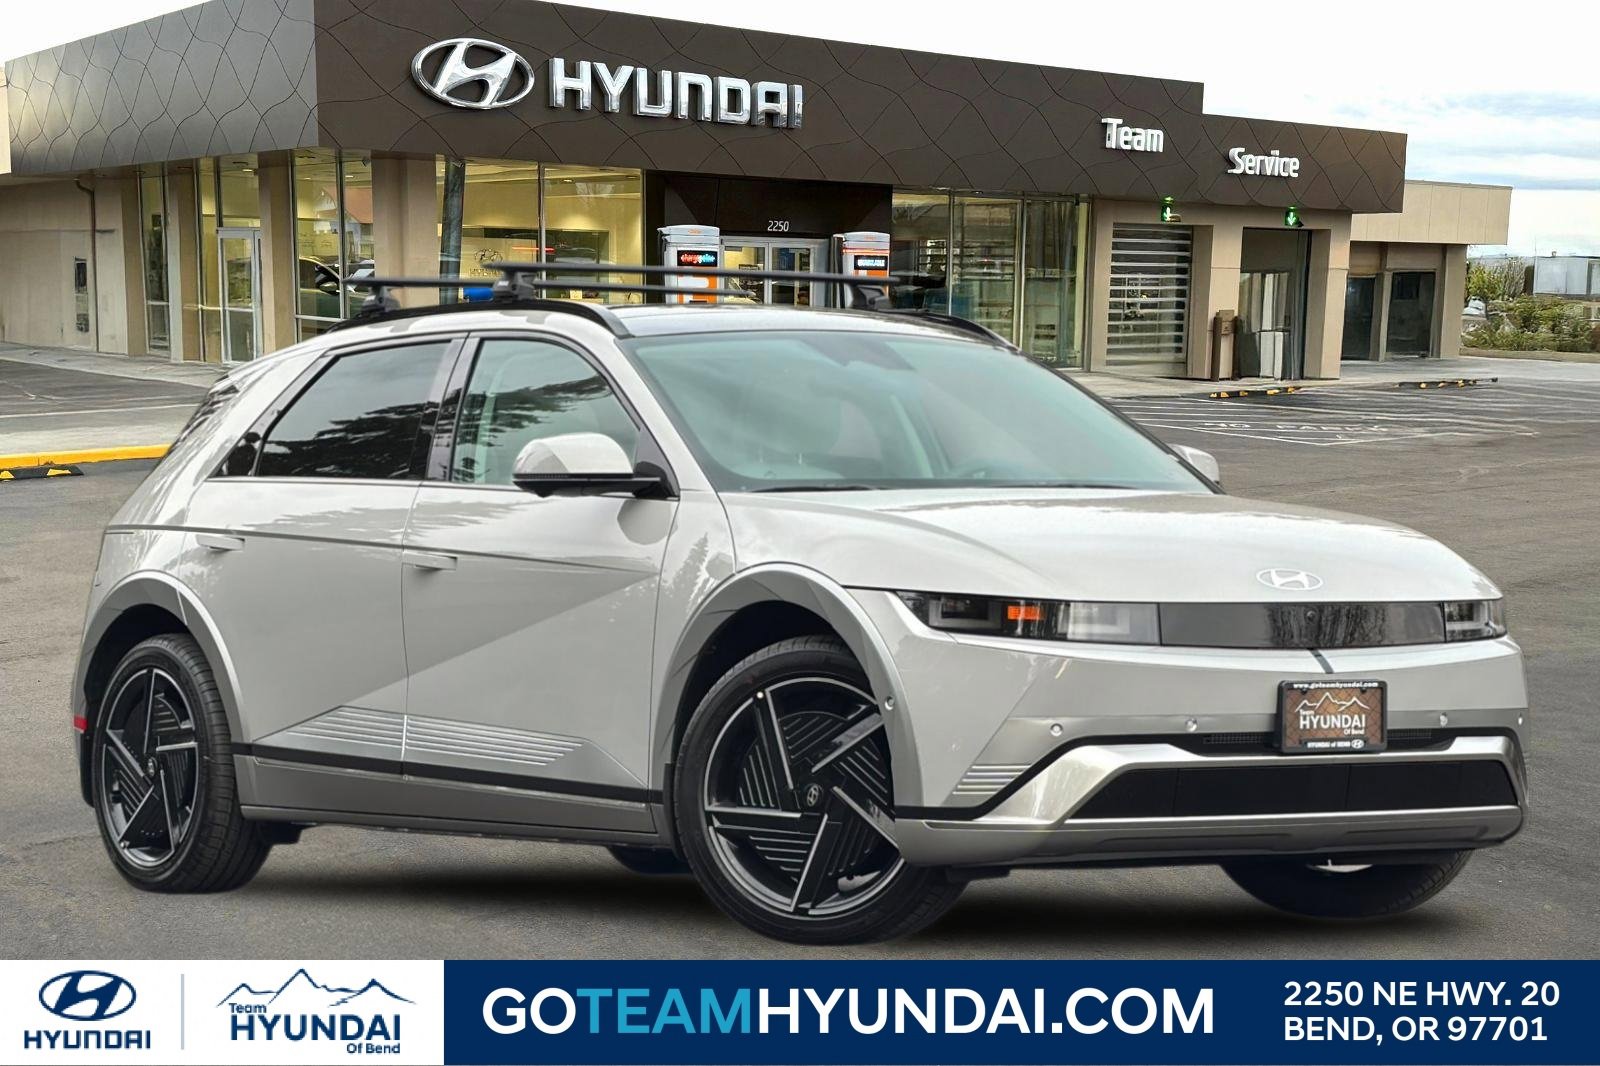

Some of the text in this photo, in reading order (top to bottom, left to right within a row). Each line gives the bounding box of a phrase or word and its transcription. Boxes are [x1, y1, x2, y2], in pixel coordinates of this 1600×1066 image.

[548, 57, 803, 129] HYUNDAI
[1101, 117, 1164, 152] Team
[1227, 147, 1300, 178] Service
[767, 220, 790, 232] 2250
[1299, 714, 1366, 729] HYUNDAI
